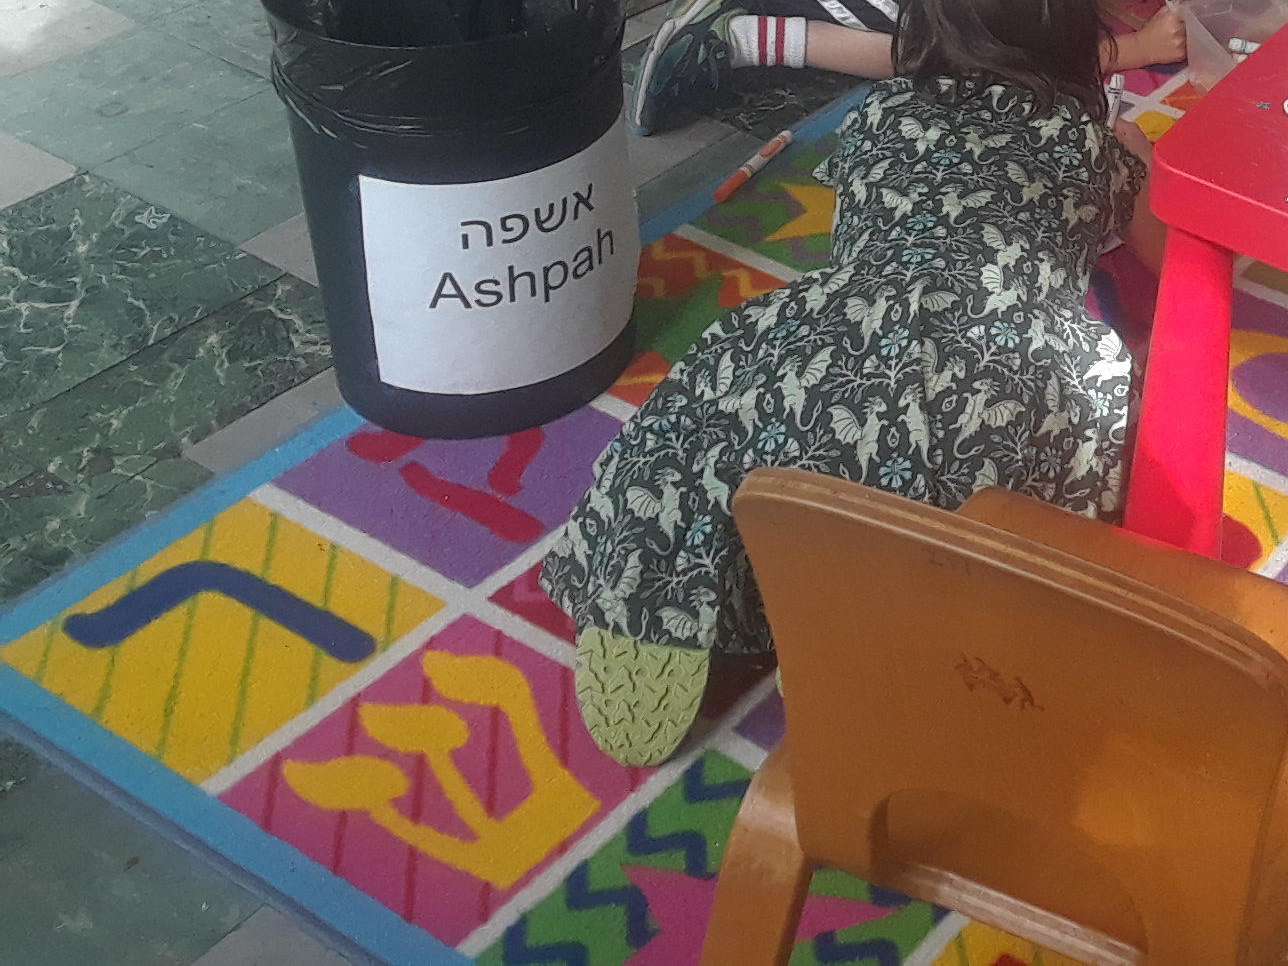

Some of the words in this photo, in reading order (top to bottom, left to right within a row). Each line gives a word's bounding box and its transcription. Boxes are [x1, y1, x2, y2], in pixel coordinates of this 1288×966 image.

[460, 182, 595, 250] אשפה
[428, 227, 615, 309] Ashpah
[281, 649, 602, 891] ש
